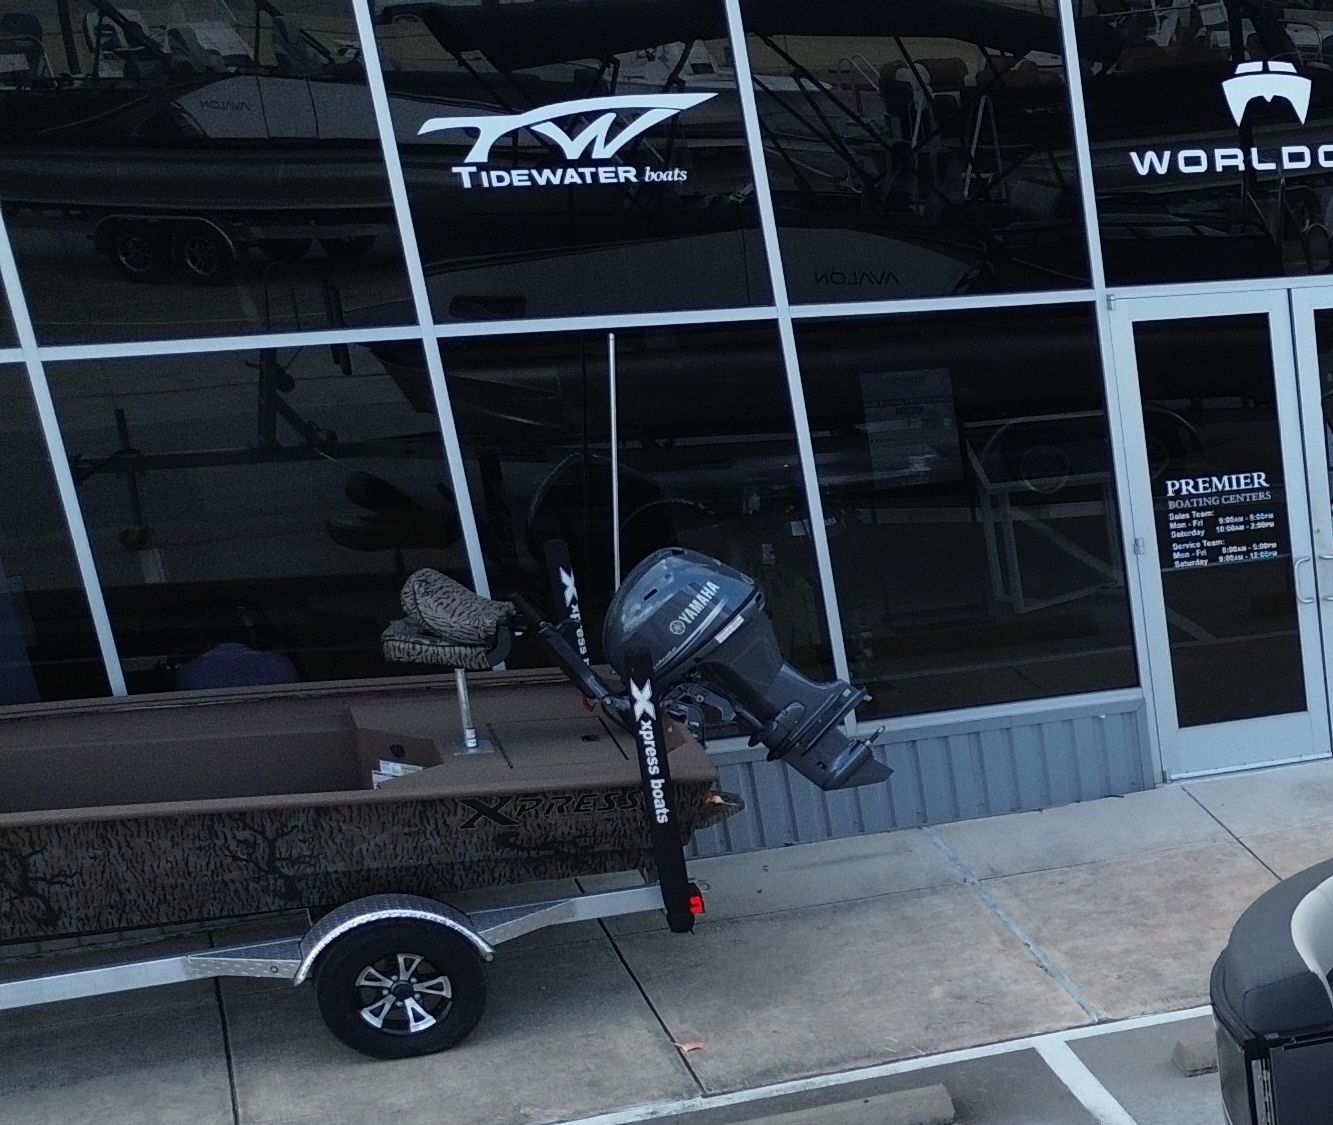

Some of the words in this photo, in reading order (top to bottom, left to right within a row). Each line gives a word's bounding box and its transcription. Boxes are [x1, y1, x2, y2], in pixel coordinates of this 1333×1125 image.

[452, 165, 638, 189] TIDEWATER
[644, 167, 688, 182] boats
[1165, 471, 1270, 497] PREMIER
[1167, 496, 1219, 509] BOATING
[1221, 491, 1272, 504] CENTERS
[678, 580, 720, 625] YAMAHA
[639, 720, 660, 775] xpress
[650, 779, 672, 824] boats
